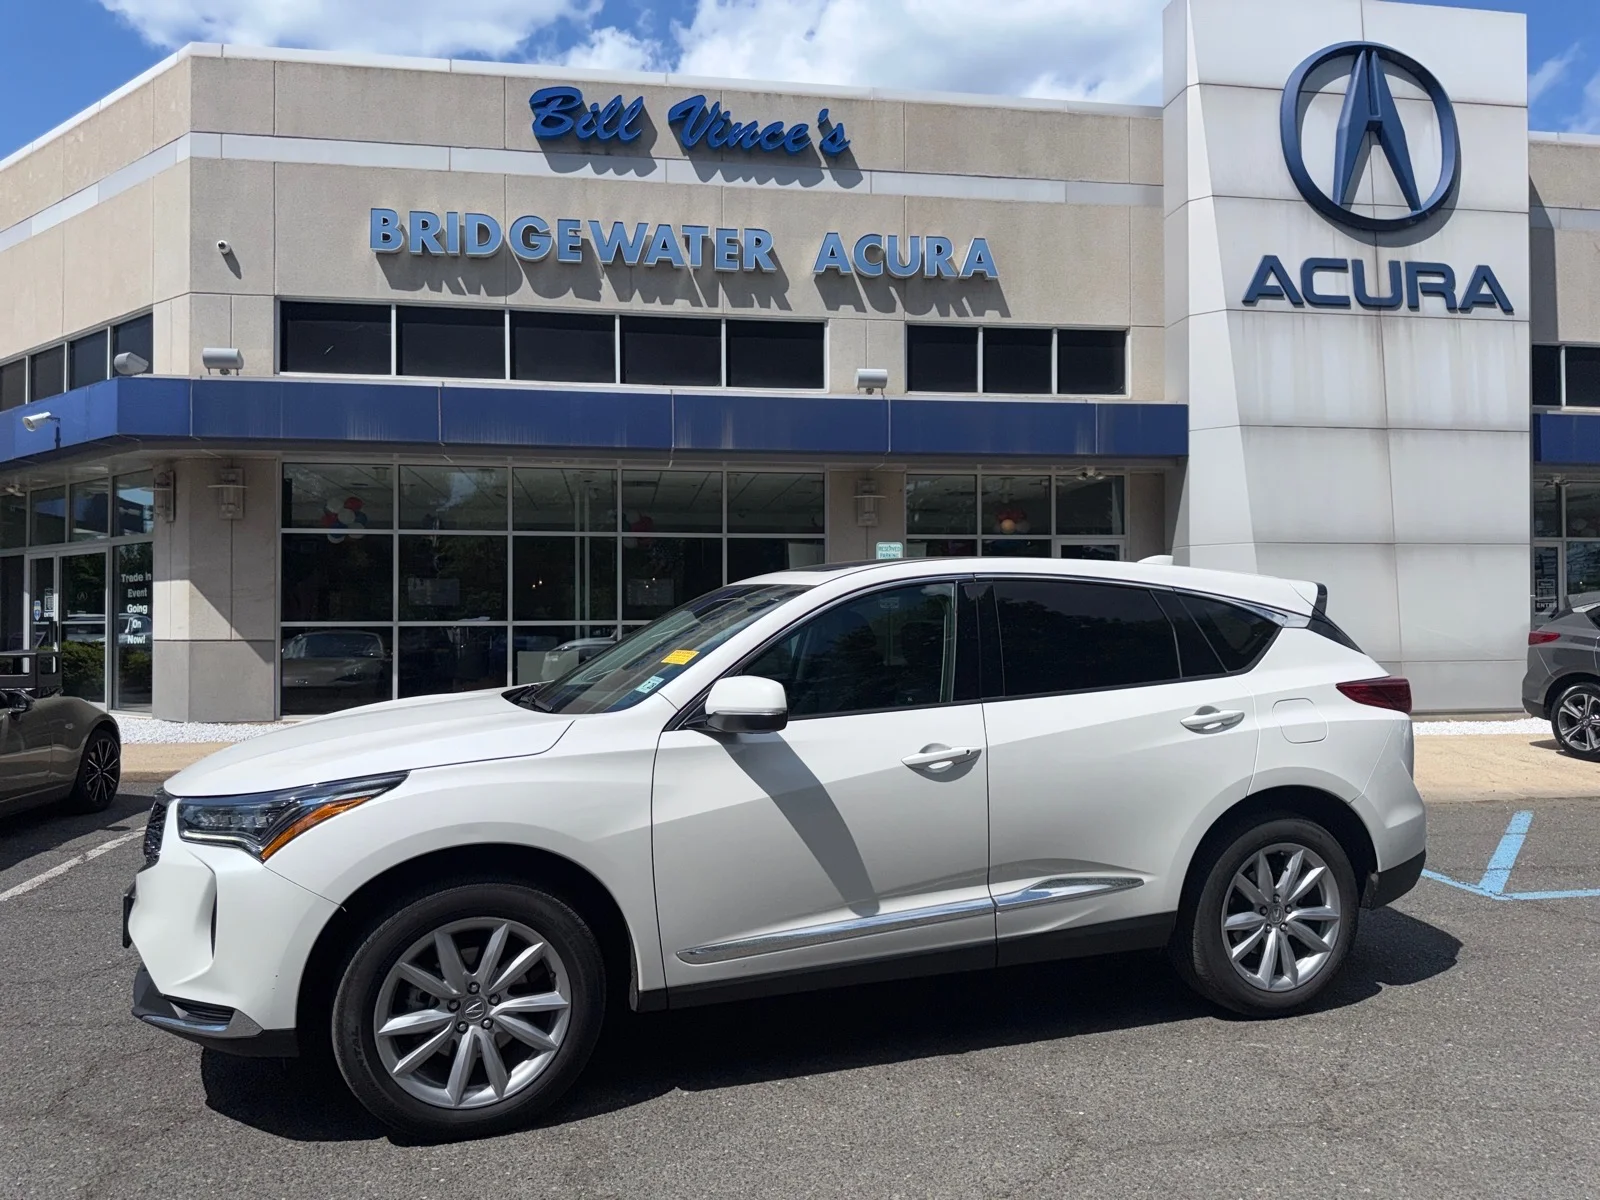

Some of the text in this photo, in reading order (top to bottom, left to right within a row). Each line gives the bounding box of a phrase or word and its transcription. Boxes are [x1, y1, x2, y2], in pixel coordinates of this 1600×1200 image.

[529, 86, 851, 157] Bill Vince's
[370, 208, 999, 281] BRIDGEWATER ACURA
[1242, 254, 1515, 316] ACURA
[121, 573, 144, 583] Trade
[127, 588, 147, 598] Event
[127, 604, 148, 614] Going
[132, 619, 142, 628] On
[127, 635, 146, 644] Now!
